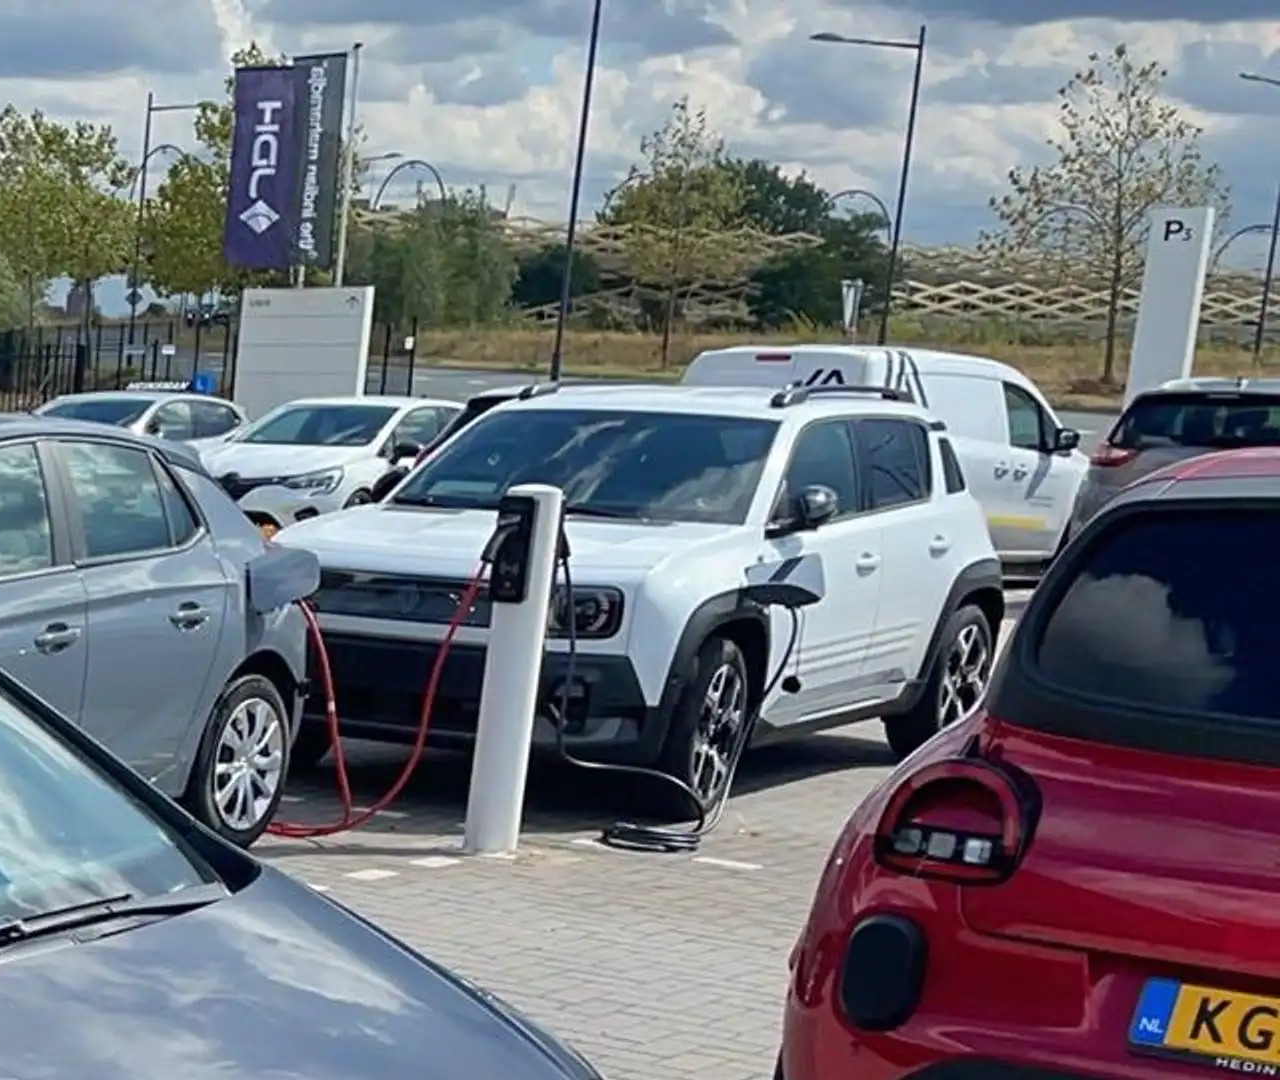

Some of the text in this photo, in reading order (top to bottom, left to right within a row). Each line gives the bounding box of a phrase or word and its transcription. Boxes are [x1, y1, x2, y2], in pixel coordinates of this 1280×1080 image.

[1139, 1016, 1164, 1034] NL
[1190, 997, 1280, 1052] KG
[1216, 1057, 1277, 1076] HEDIN
